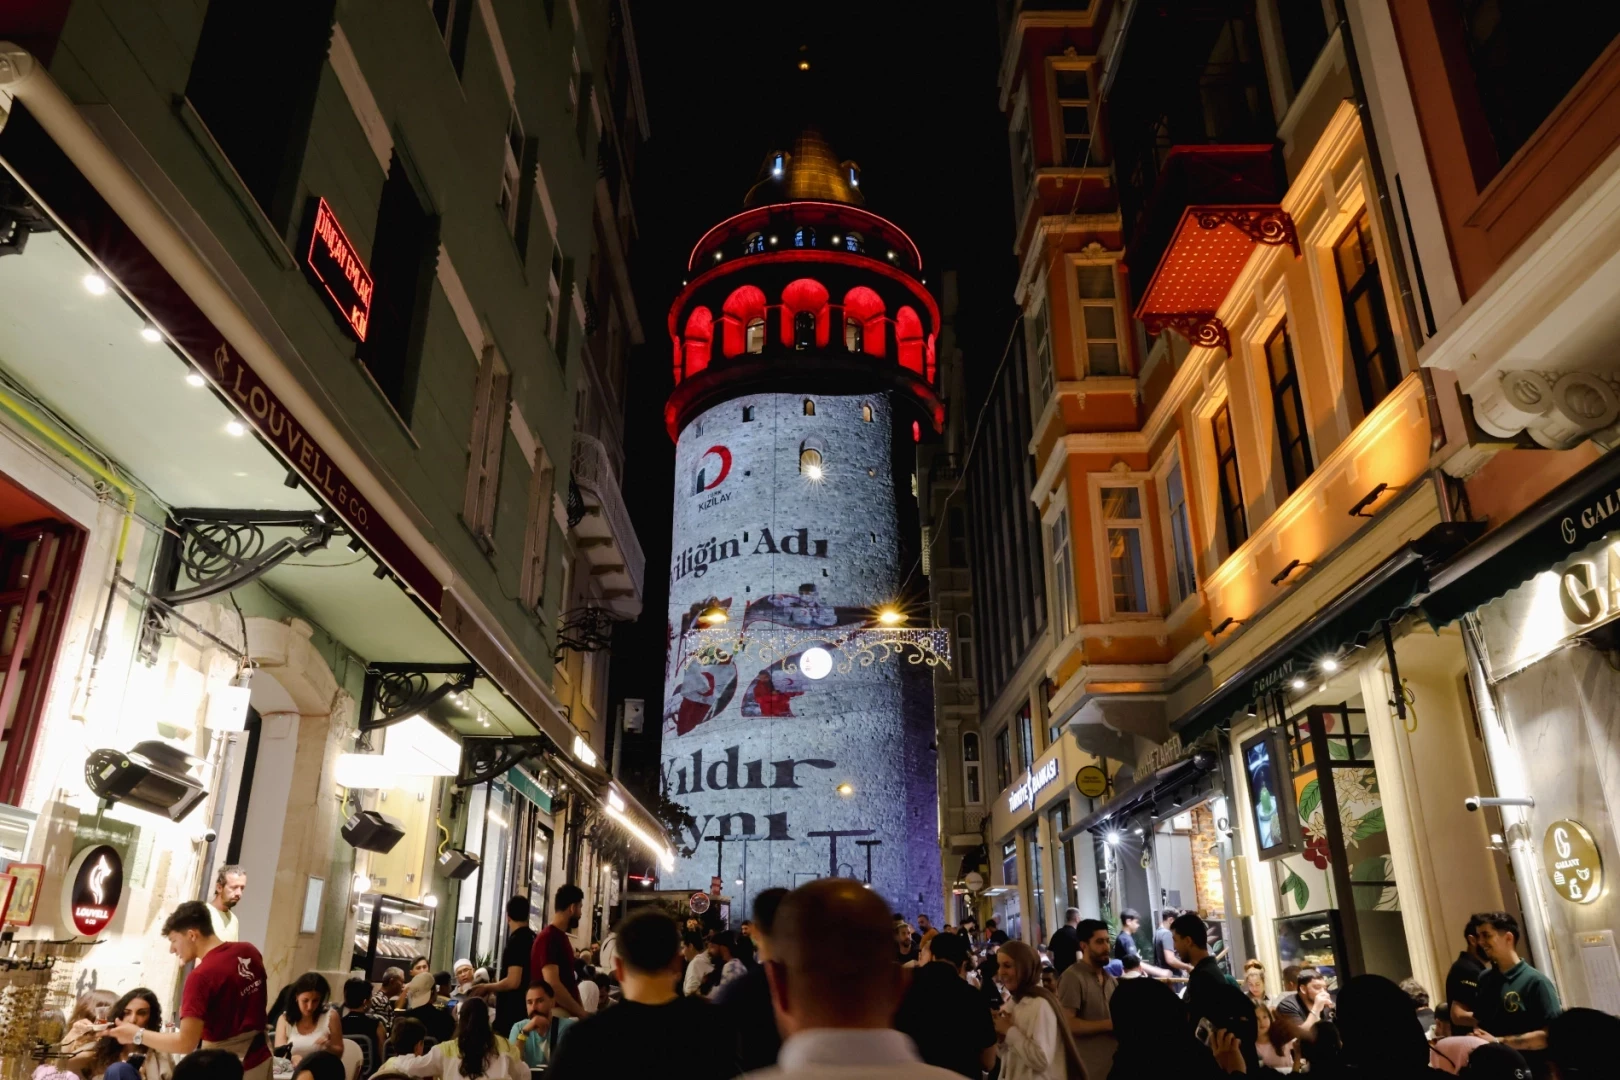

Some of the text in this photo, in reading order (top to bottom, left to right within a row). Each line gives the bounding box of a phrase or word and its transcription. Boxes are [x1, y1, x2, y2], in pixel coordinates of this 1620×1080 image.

[345, 254, 371, 308] EMLAK
[233, 364, 335, 497] LOUVELL
[338, 485, 347, 505] &
[1581, 487, 1620, 529] GAL
[671, 528, 828, 583] iliğin Adı
[676, 812, 795, 855] ynı
[75, 907, 109, 919] LOUVELL
